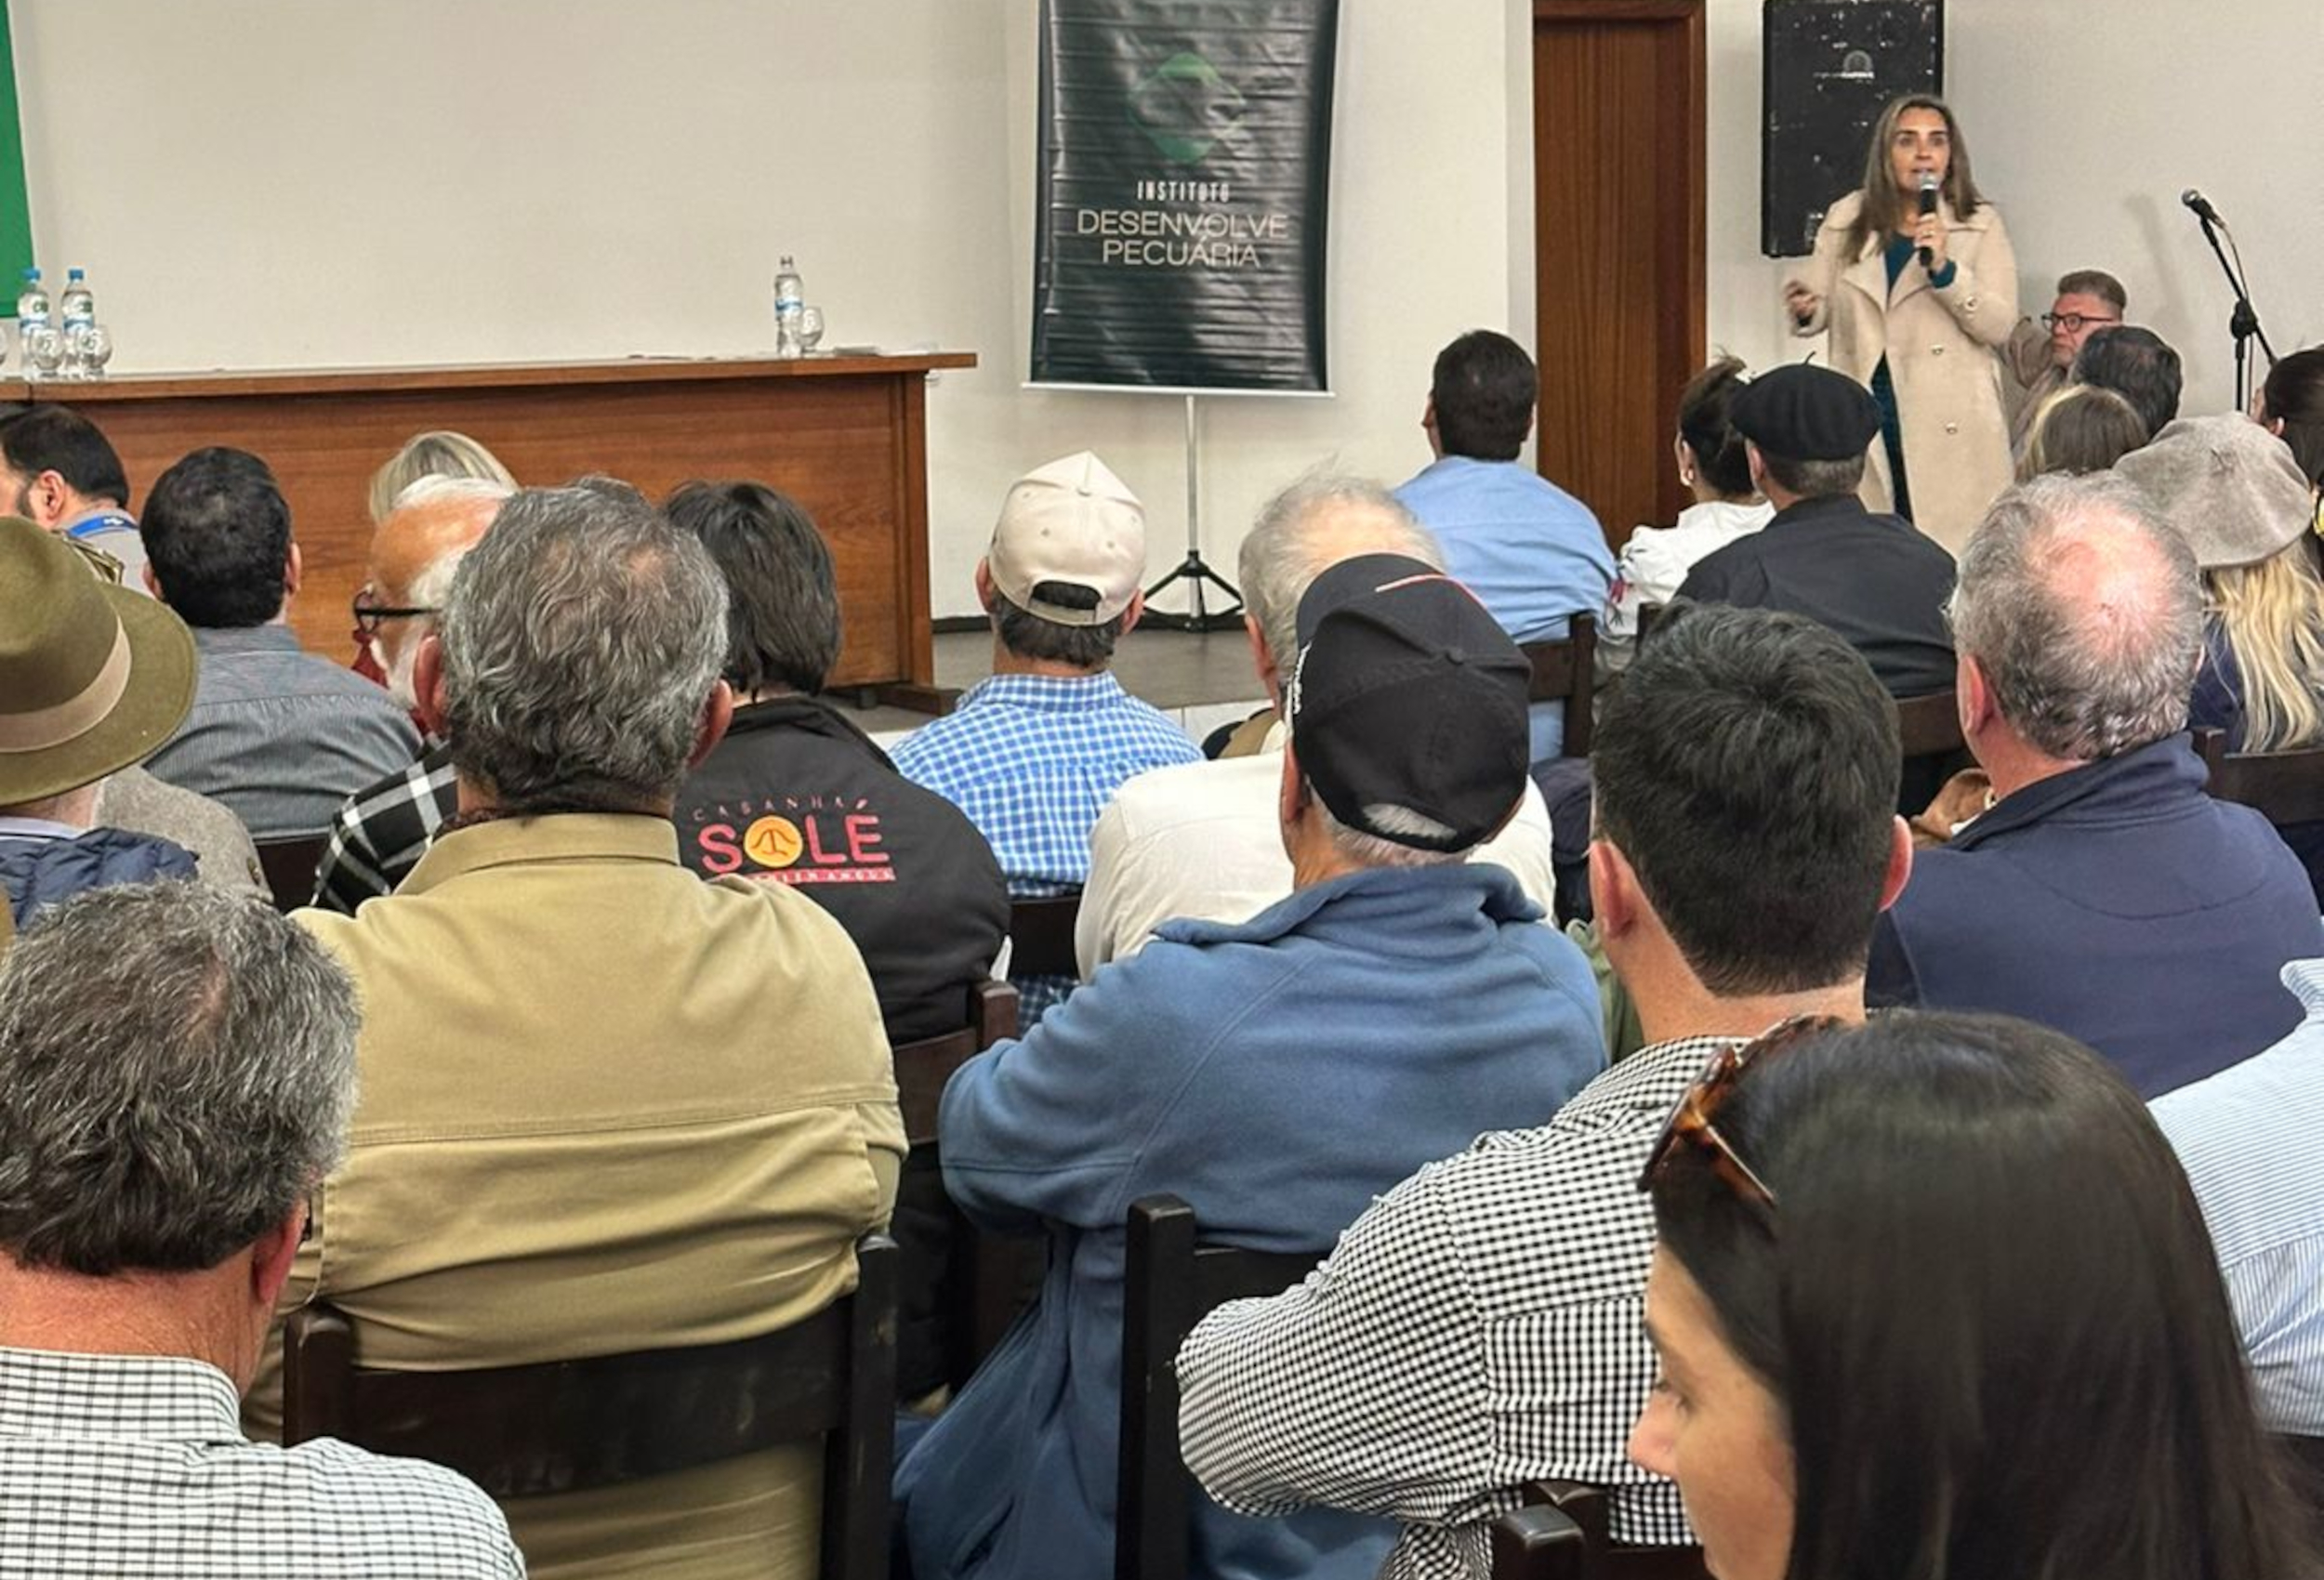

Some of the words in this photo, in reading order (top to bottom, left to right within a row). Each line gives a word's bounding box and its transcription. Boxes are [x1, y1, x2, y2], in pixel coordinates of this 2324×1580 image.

[1137, 179, 1230, 204] INSTITUTO
[1076, 209, 1289, 239] DESENVOLVE
[1102, 235, 1261, 269] PECUÁRIA
[692, 795, 845, 822] CABANHA
